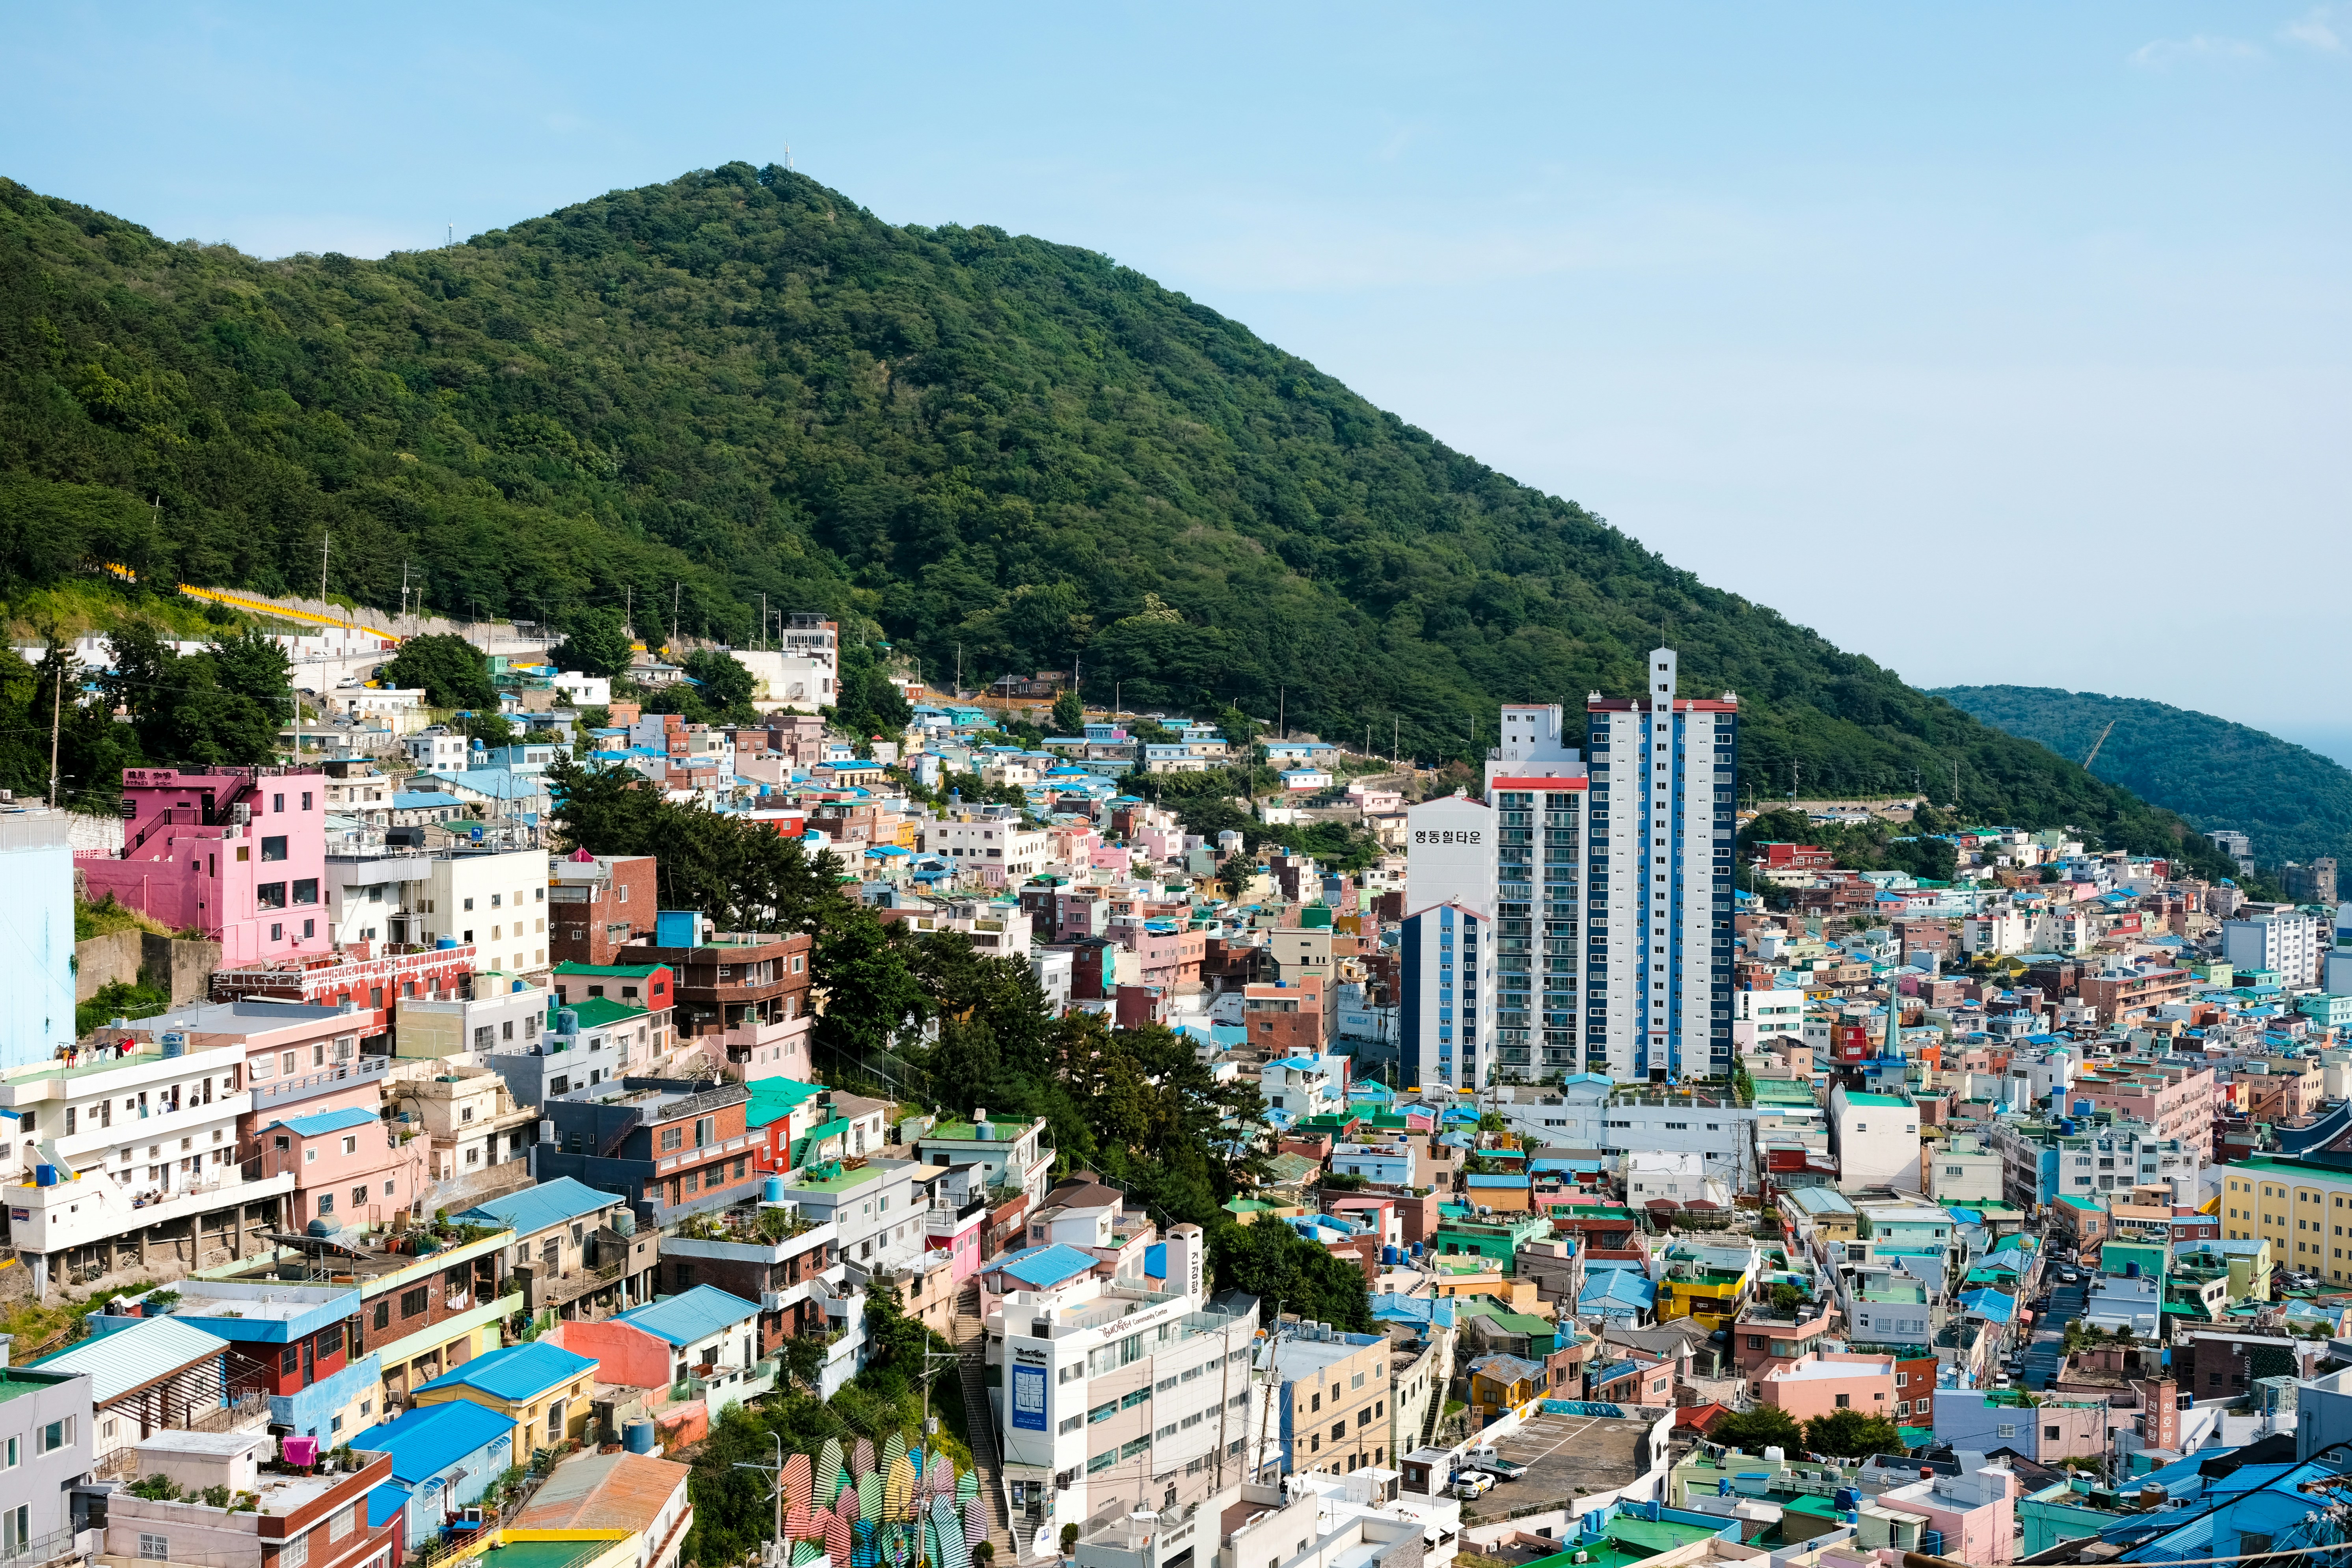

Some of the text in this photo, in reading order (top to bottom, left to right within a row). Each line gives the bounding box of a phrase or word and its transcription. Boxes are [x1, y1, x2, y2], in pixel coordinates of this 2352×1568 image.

[1415, 831, 1481, 844] 영동힐타운
[1132, 1313, 1155, 1325] Community
[2148, 1400, 2157, 1441] 천호탕
[2163, 1402, 2172, 1443] 천호탕
